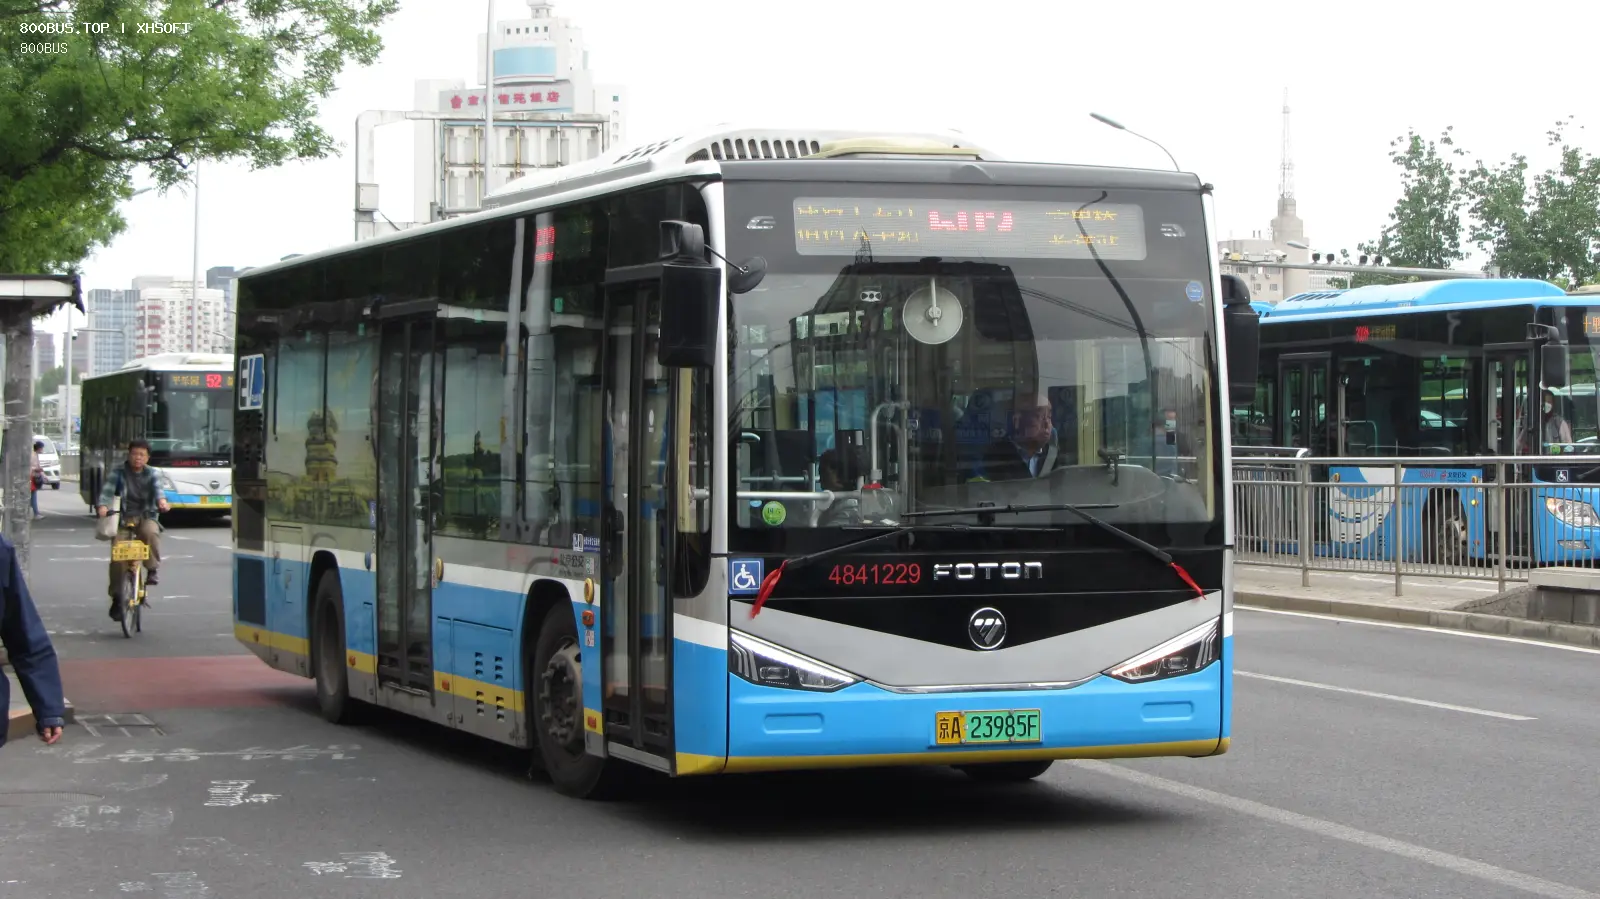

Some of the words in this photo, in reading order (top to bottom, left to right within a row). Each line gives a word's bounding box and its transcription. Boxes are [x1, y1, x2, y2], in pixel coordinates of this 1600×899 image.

[205, 373, 222, 388] 52
[828, 563, 921, 585] 4841229
[933, 561, 1043, 581] FOTON
[970, 714, 1038, 738] 23985F
